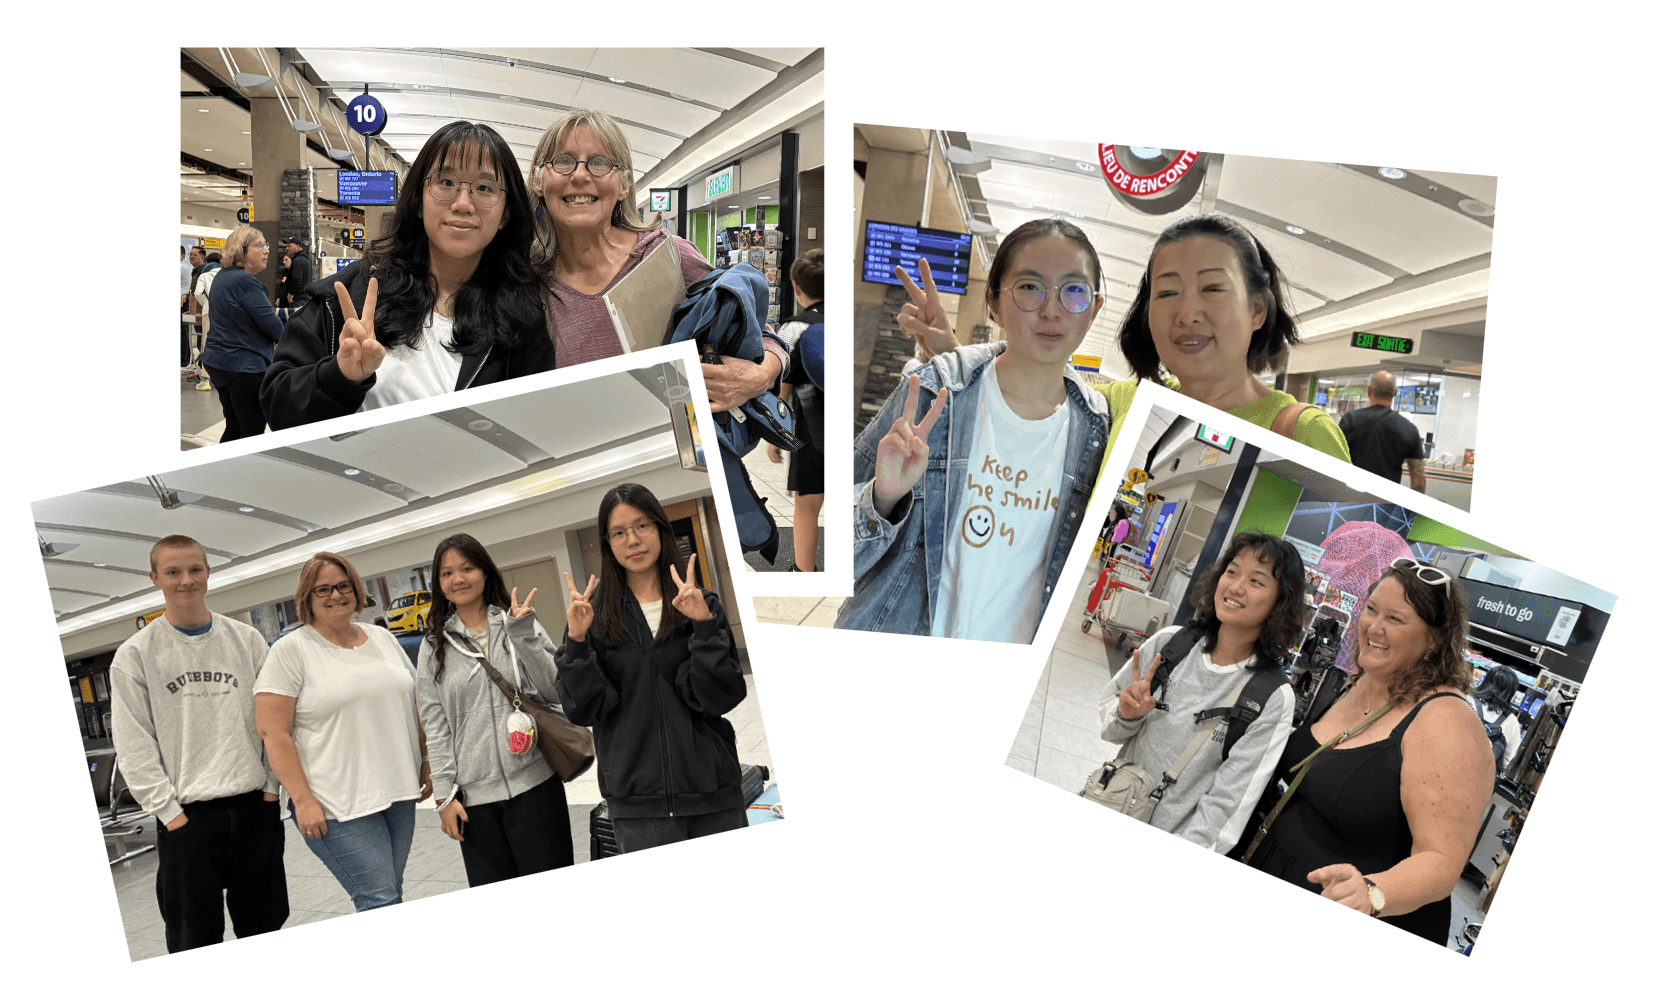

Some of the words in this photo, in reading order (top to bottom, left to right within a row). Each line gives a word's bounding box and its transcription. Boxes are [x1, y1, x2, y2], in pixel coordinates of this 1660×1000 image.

[353, 105, 376, 123] 10
[1102, 144, 1118, 173] LIEU
[1113, 169, 1131, 189] DE
[239, 212, 249, 220] 10
[1476, 596, 1503, 614] fresh
[1504, 604, 1517, 617] to
[1516, 607, 1533, 622] go
